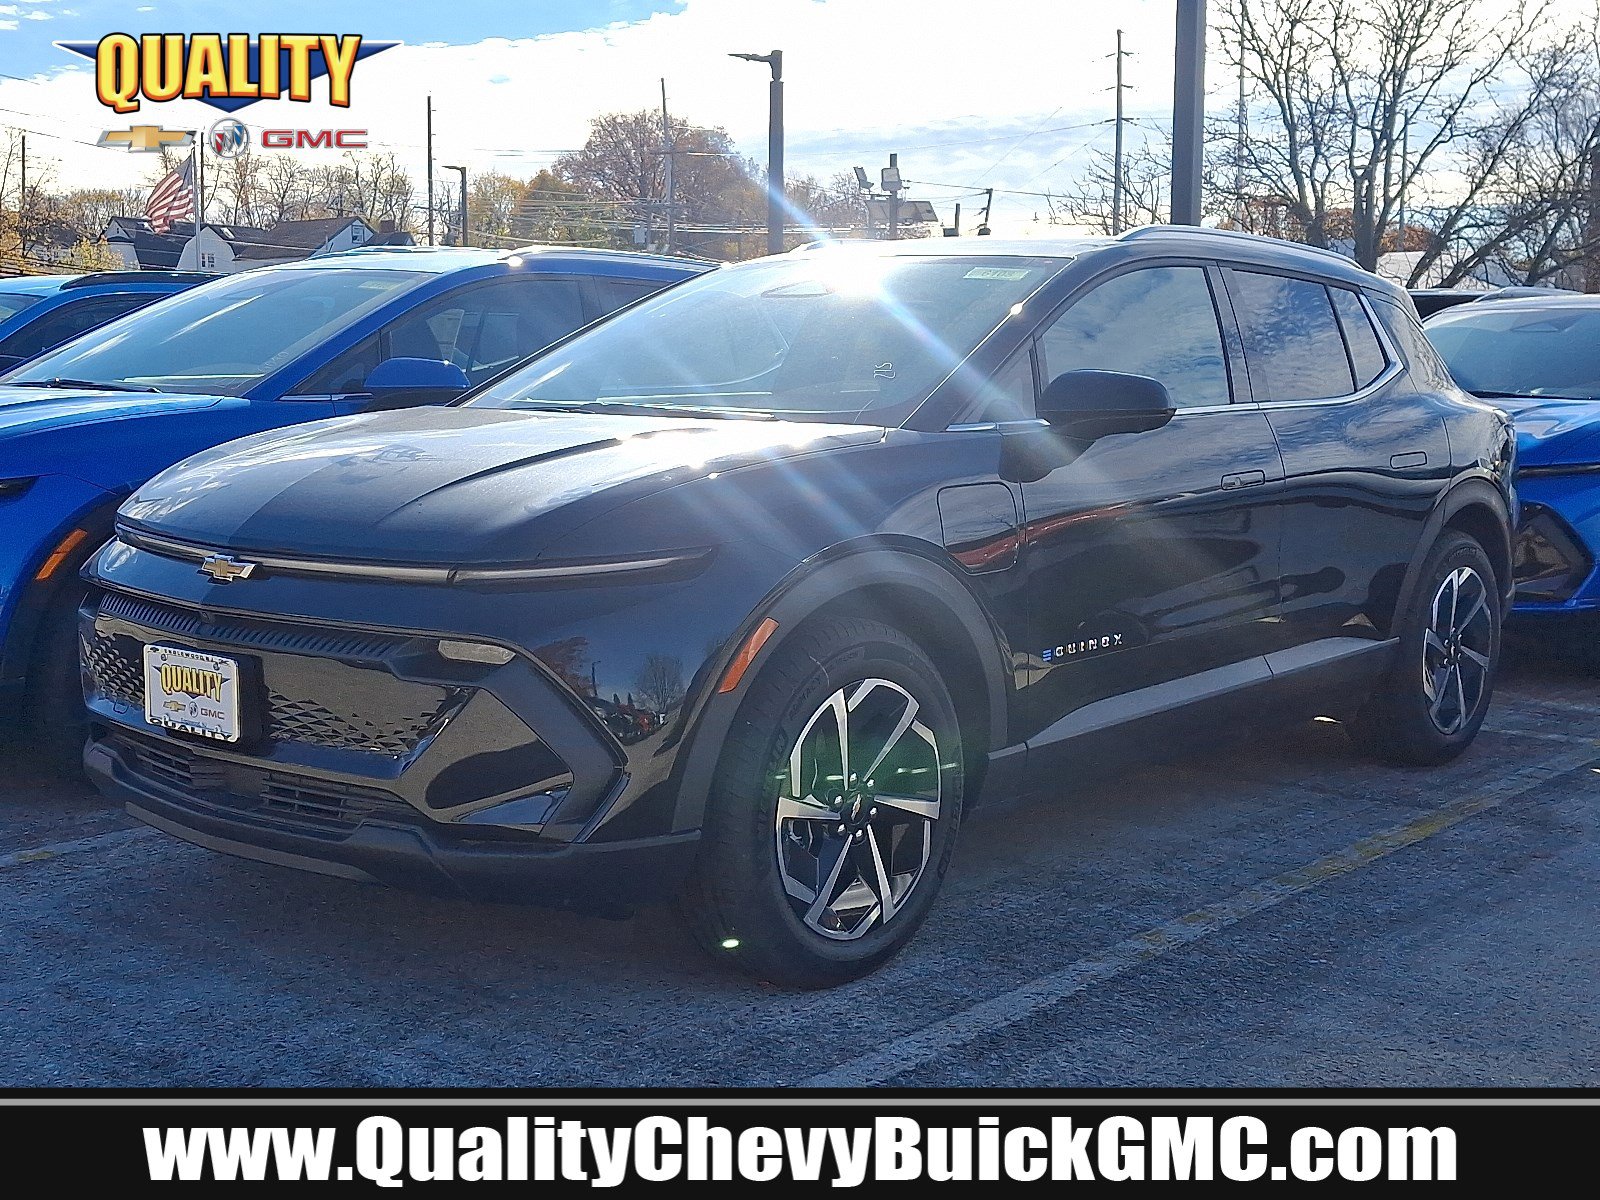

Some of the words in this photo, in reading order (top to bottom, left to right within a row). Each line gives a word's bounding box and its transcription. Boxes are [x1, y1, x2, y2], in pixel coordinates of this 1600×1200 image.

[1042, 633, 1123, 662] EQUINOX
[160, 663, 222, 703] QUALITY
[200, 707, 225, 720] GMC
[149, 718, 232, 740] QUALITY
